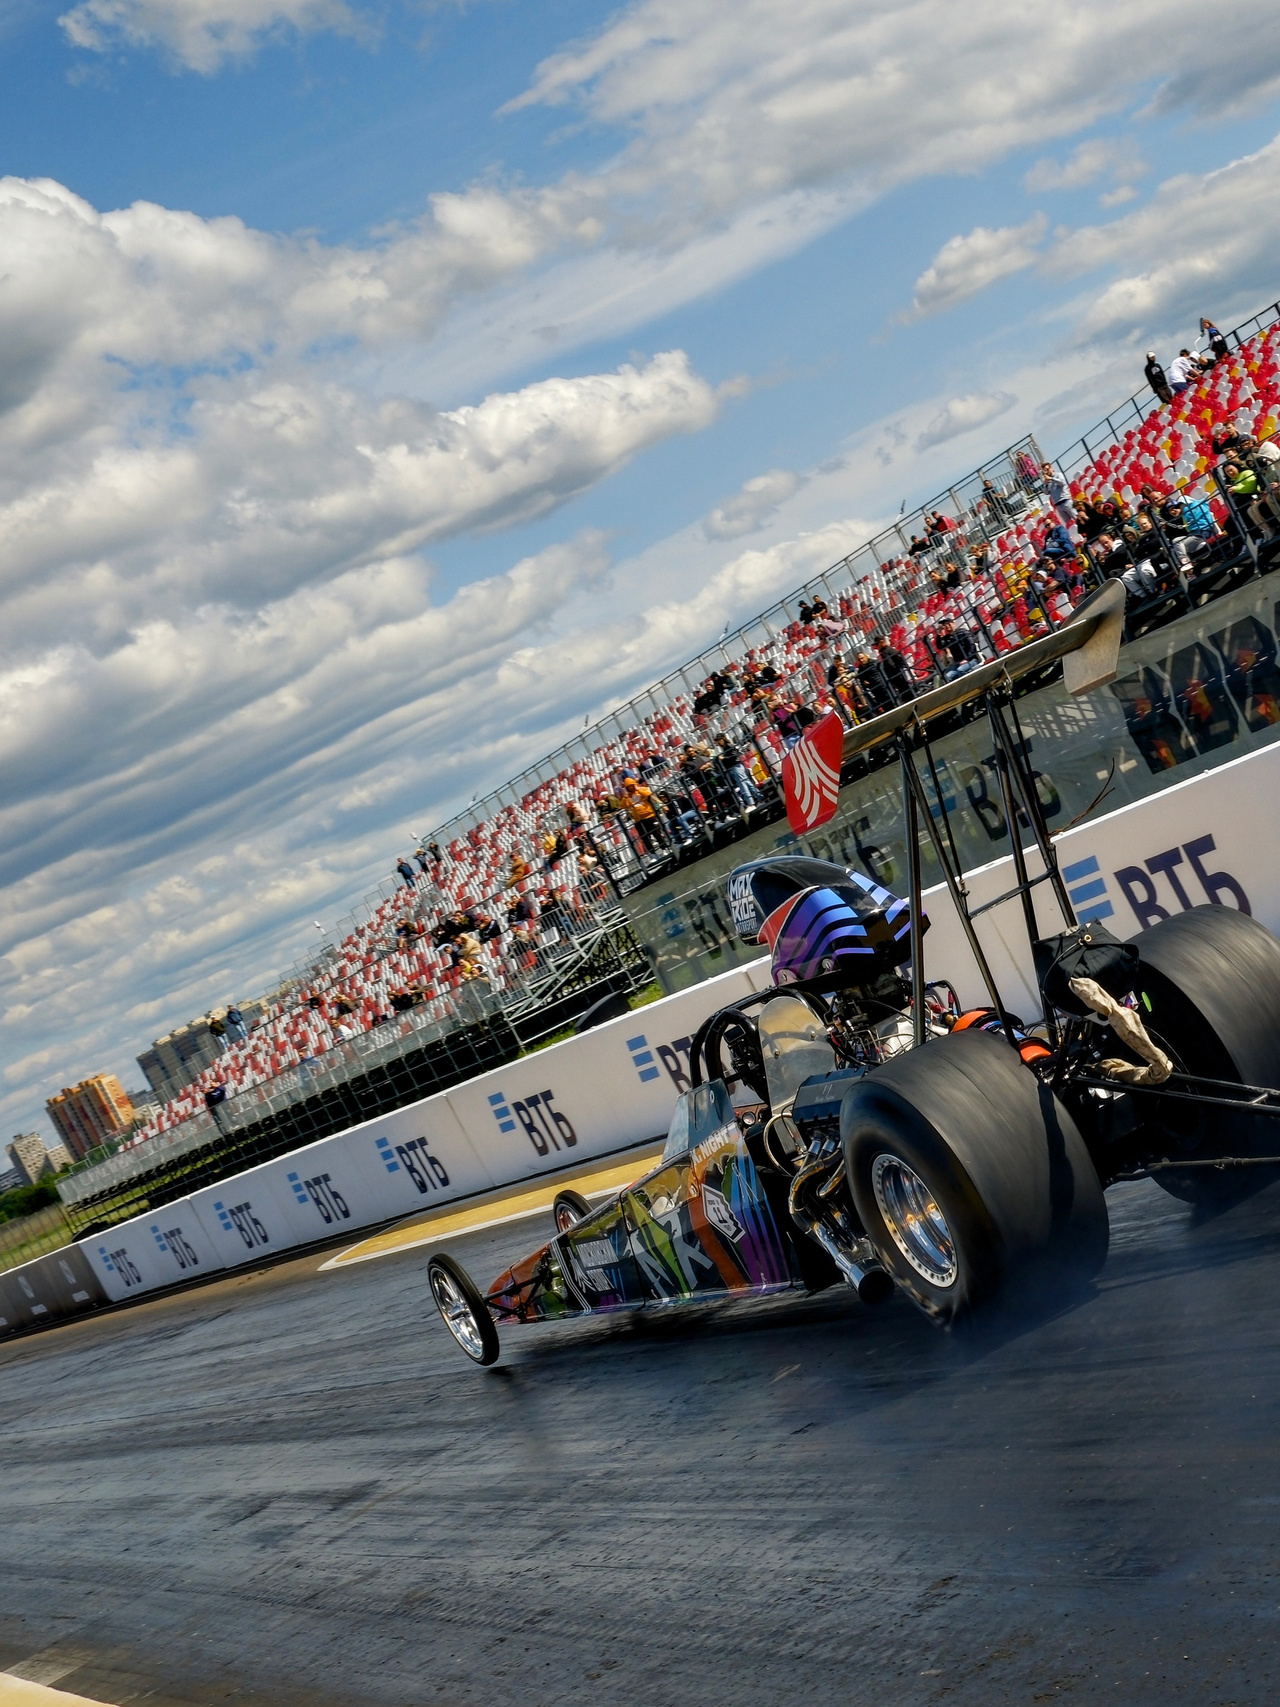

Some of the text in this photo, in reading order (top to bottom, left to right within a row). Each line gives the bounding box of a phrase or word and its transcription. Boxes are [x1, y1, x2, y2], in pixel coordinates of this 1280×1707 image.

[730, 872, 755, 901] MAX
[731, 895, 756, 923] RIDE
[512, 1089, 577, 1156] ВТБ
[395, 1136, 450, 1194] ВТБ
[304, 1173, 350, 1224] ВТБ
[163, 1227, 199, 1269] ВТБ
[228, 1202, 268, 1249] ВТБ
